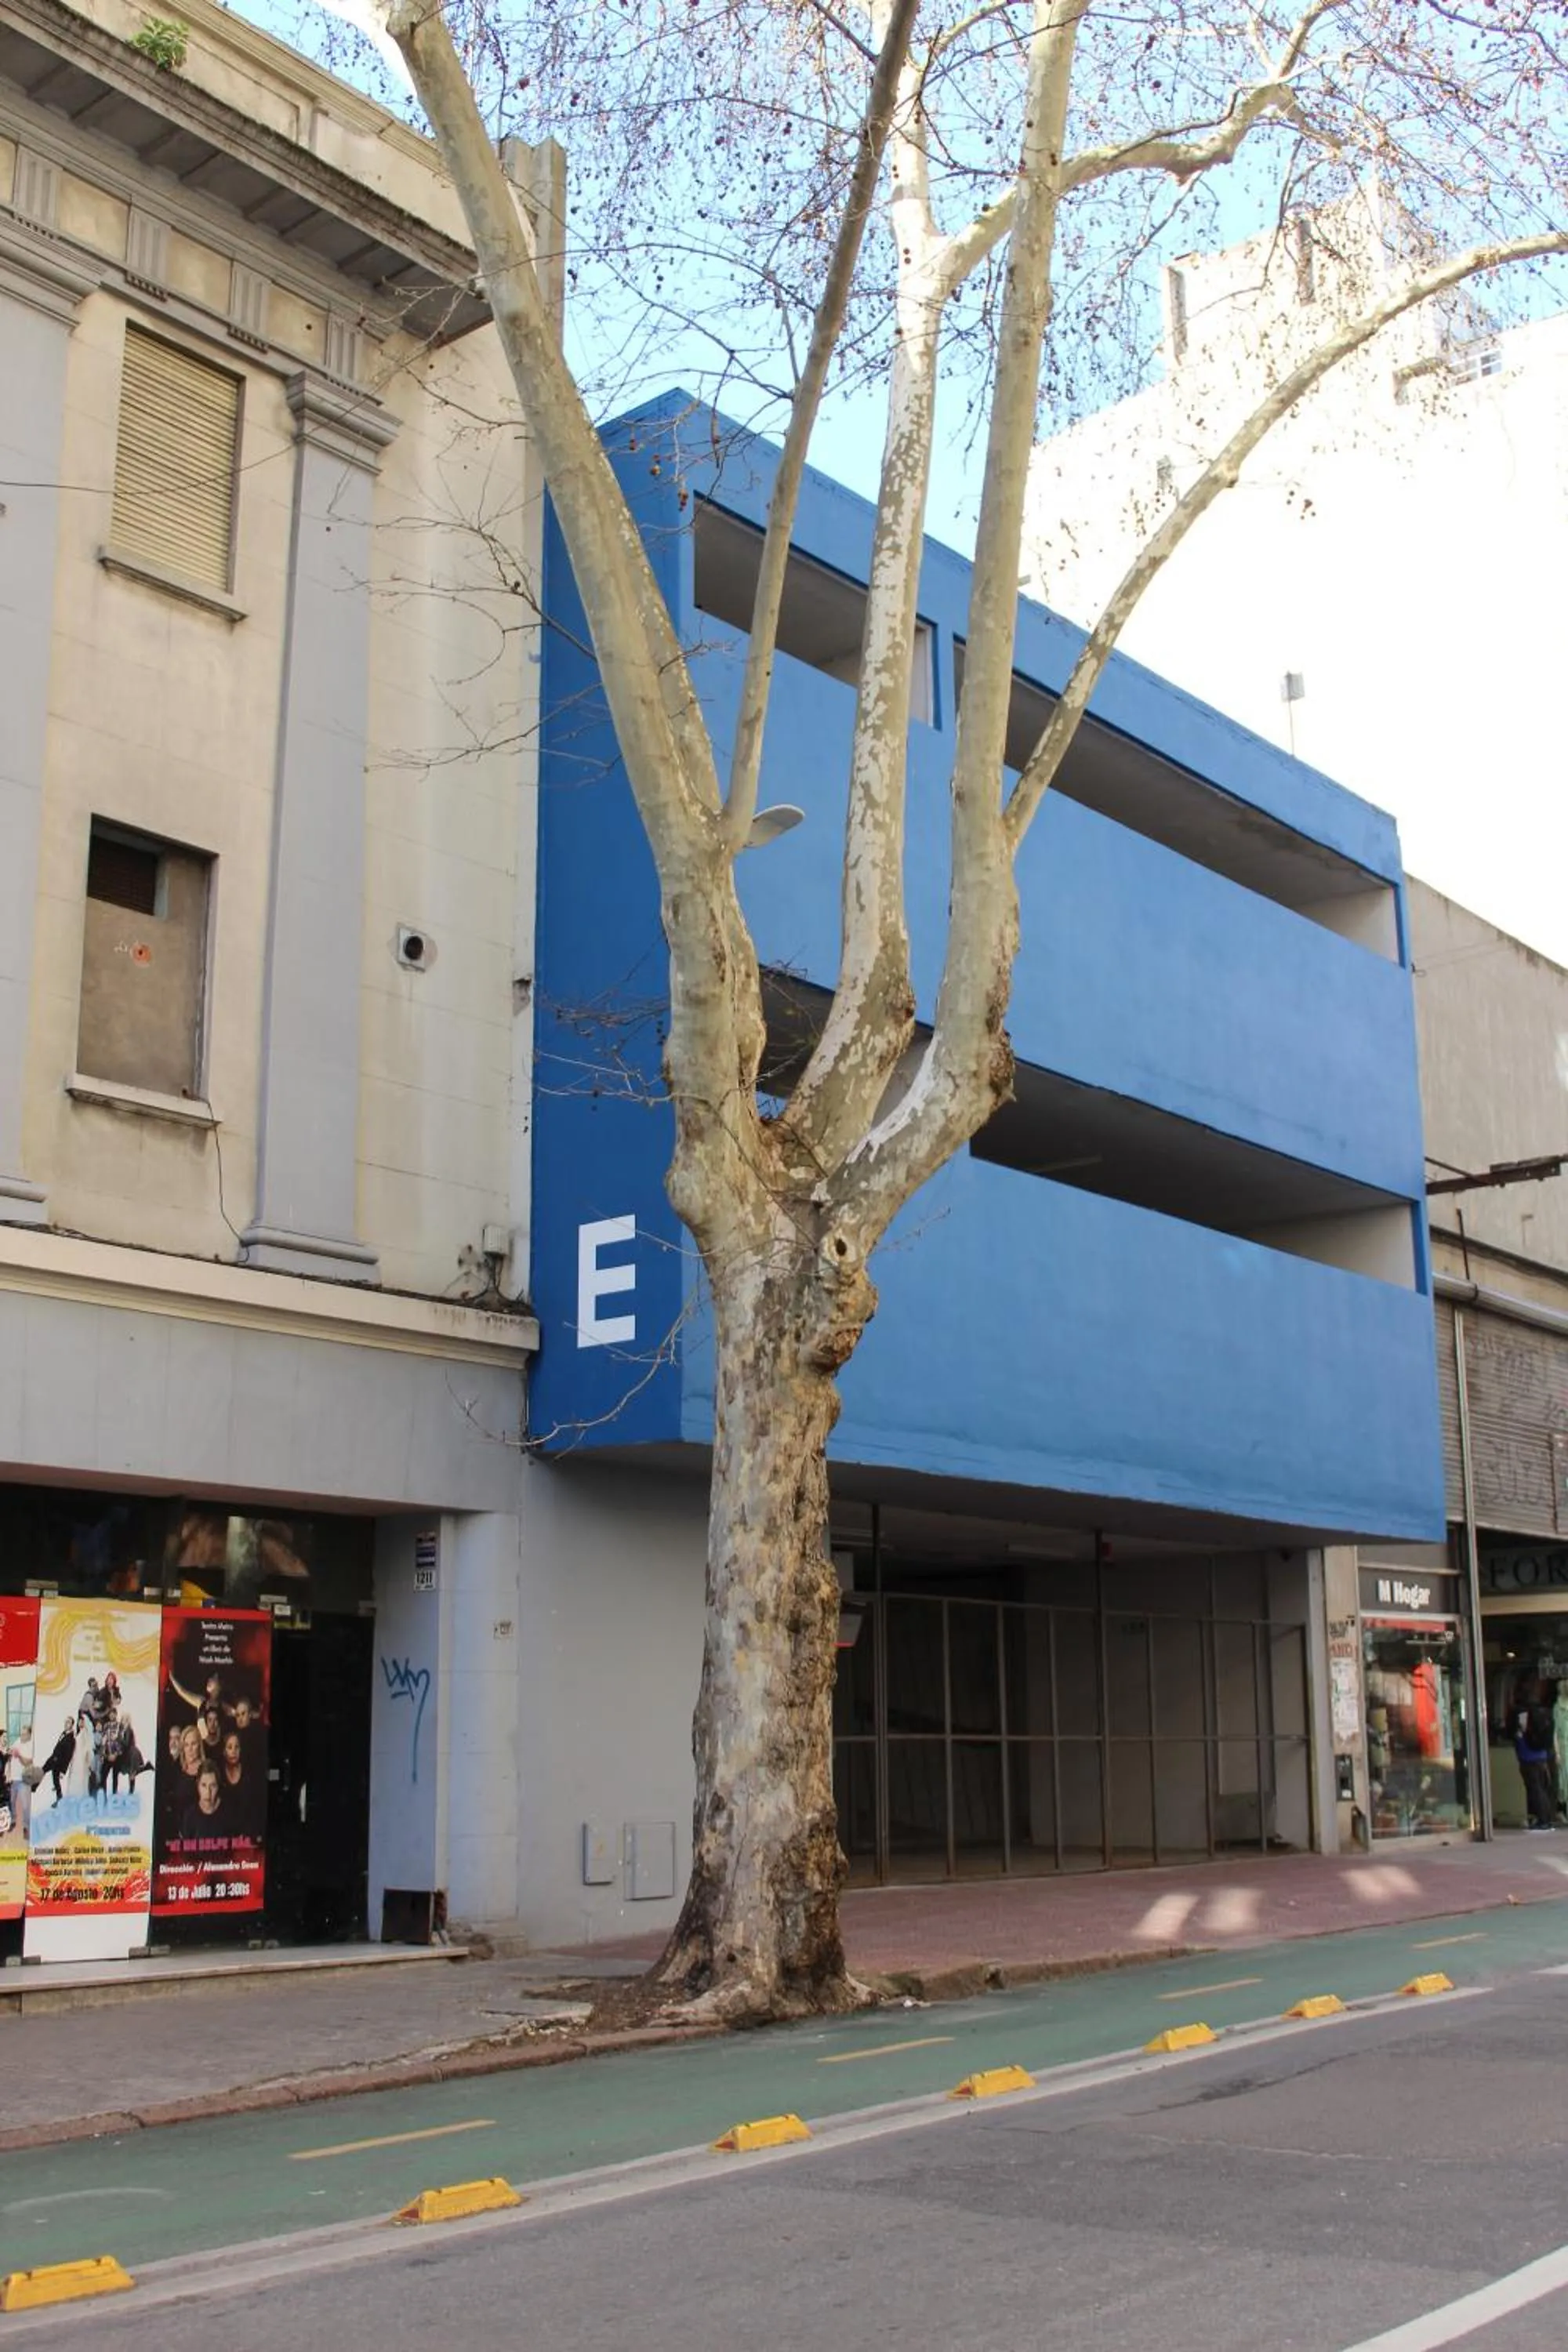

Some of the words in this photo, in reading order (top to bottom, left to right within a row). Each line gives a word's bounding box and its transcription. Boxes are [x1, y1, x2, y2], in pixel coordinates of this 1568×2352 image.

[577, 1214, 636, 1348] E
[416, 1571, 433, 1584] 1211
[1392, 1581, 1431, 1610] Hogar
[178, 1885, 189, 1900] de
